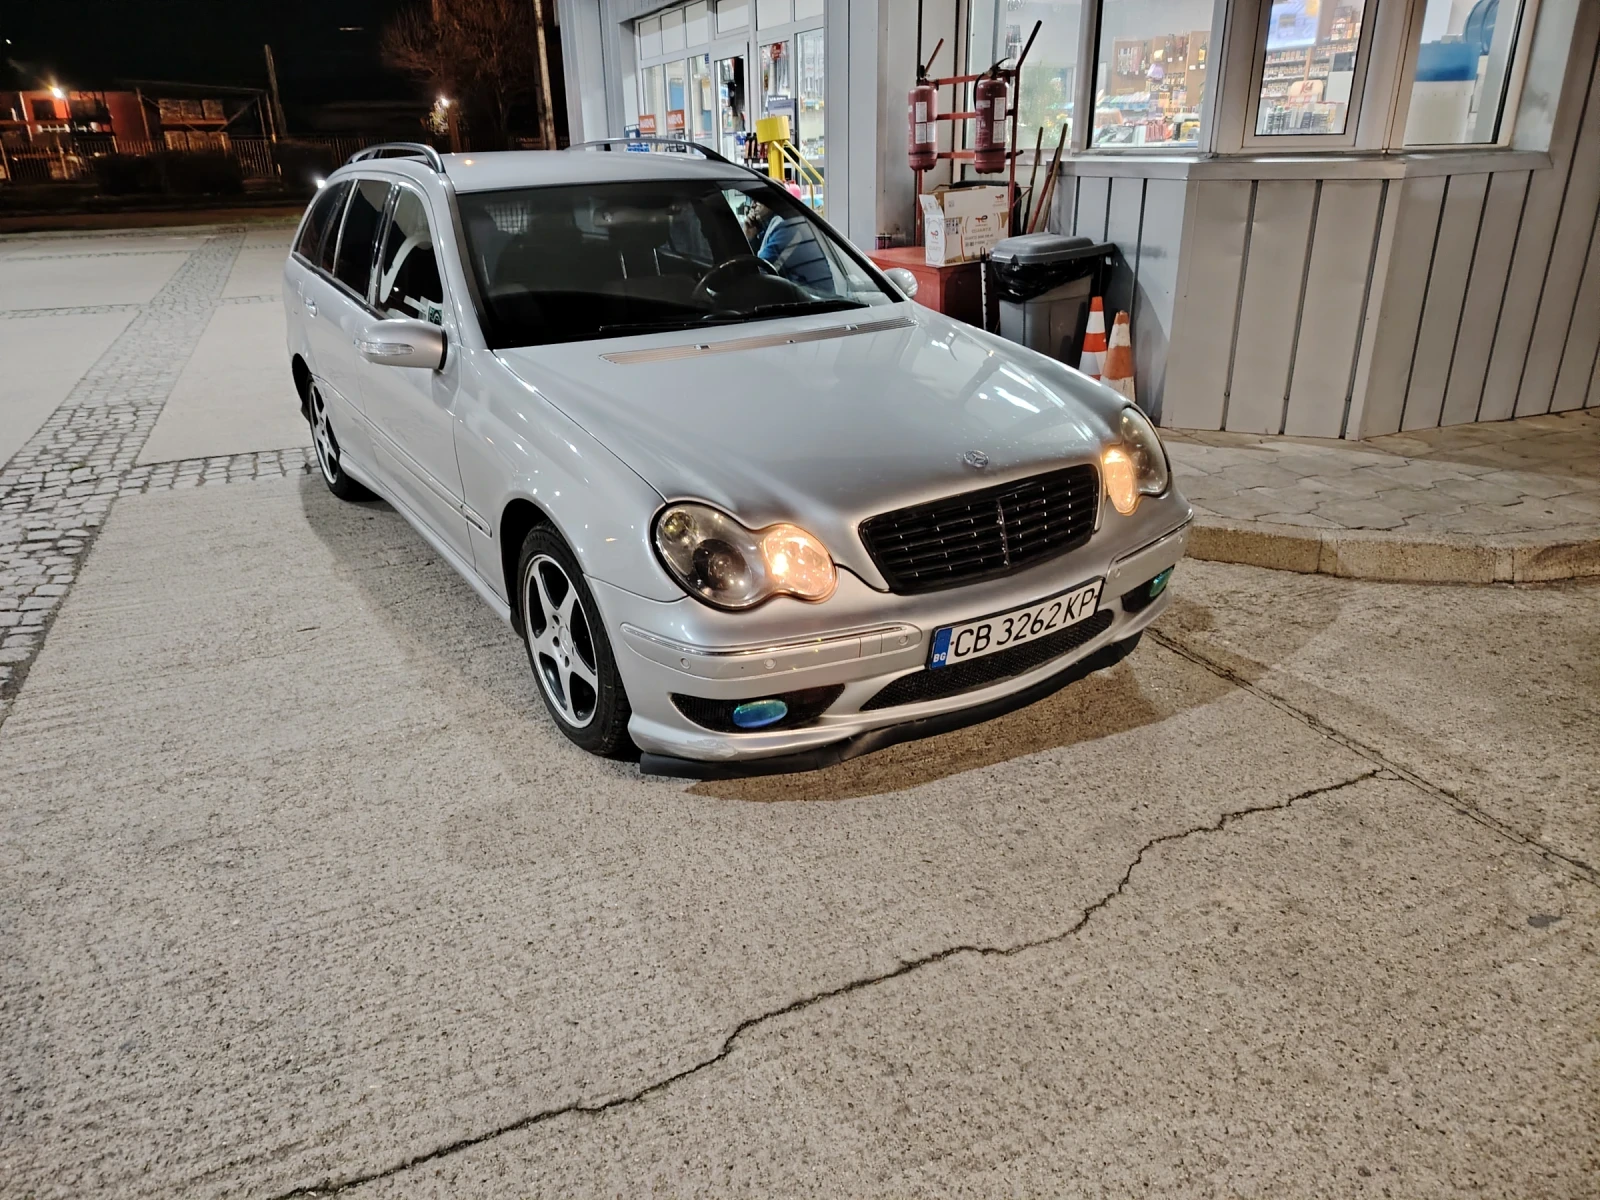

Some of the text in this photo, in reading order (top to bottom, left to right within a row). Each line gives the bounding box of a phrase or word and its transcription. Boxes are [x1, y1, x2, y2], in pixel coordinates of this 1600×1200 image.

[954, 587, 1096, 657] CB 3262 KP
[933, 652, 946, 662] BG
